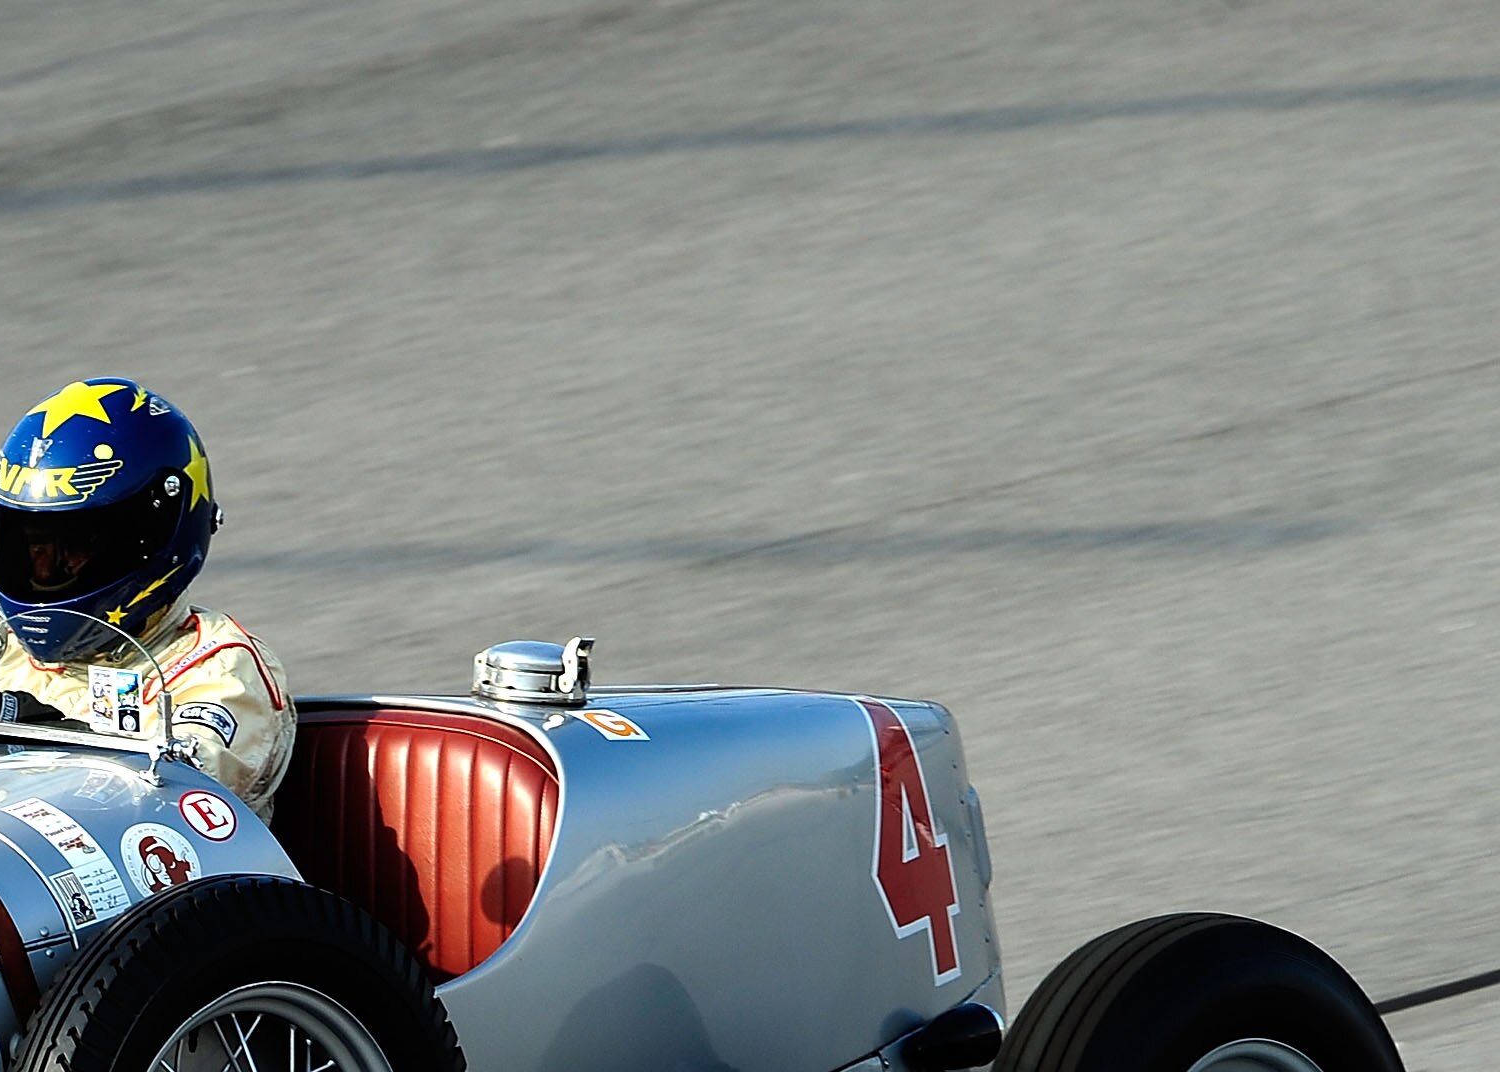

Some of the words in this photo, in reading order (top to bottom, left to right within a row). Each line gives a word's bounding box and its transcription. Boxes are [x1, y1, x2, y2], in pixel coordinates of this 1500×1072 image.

[583, 713, 640, 736] G
[186, 798, 229, 832] E
[855, 696, 961, 986] 4
